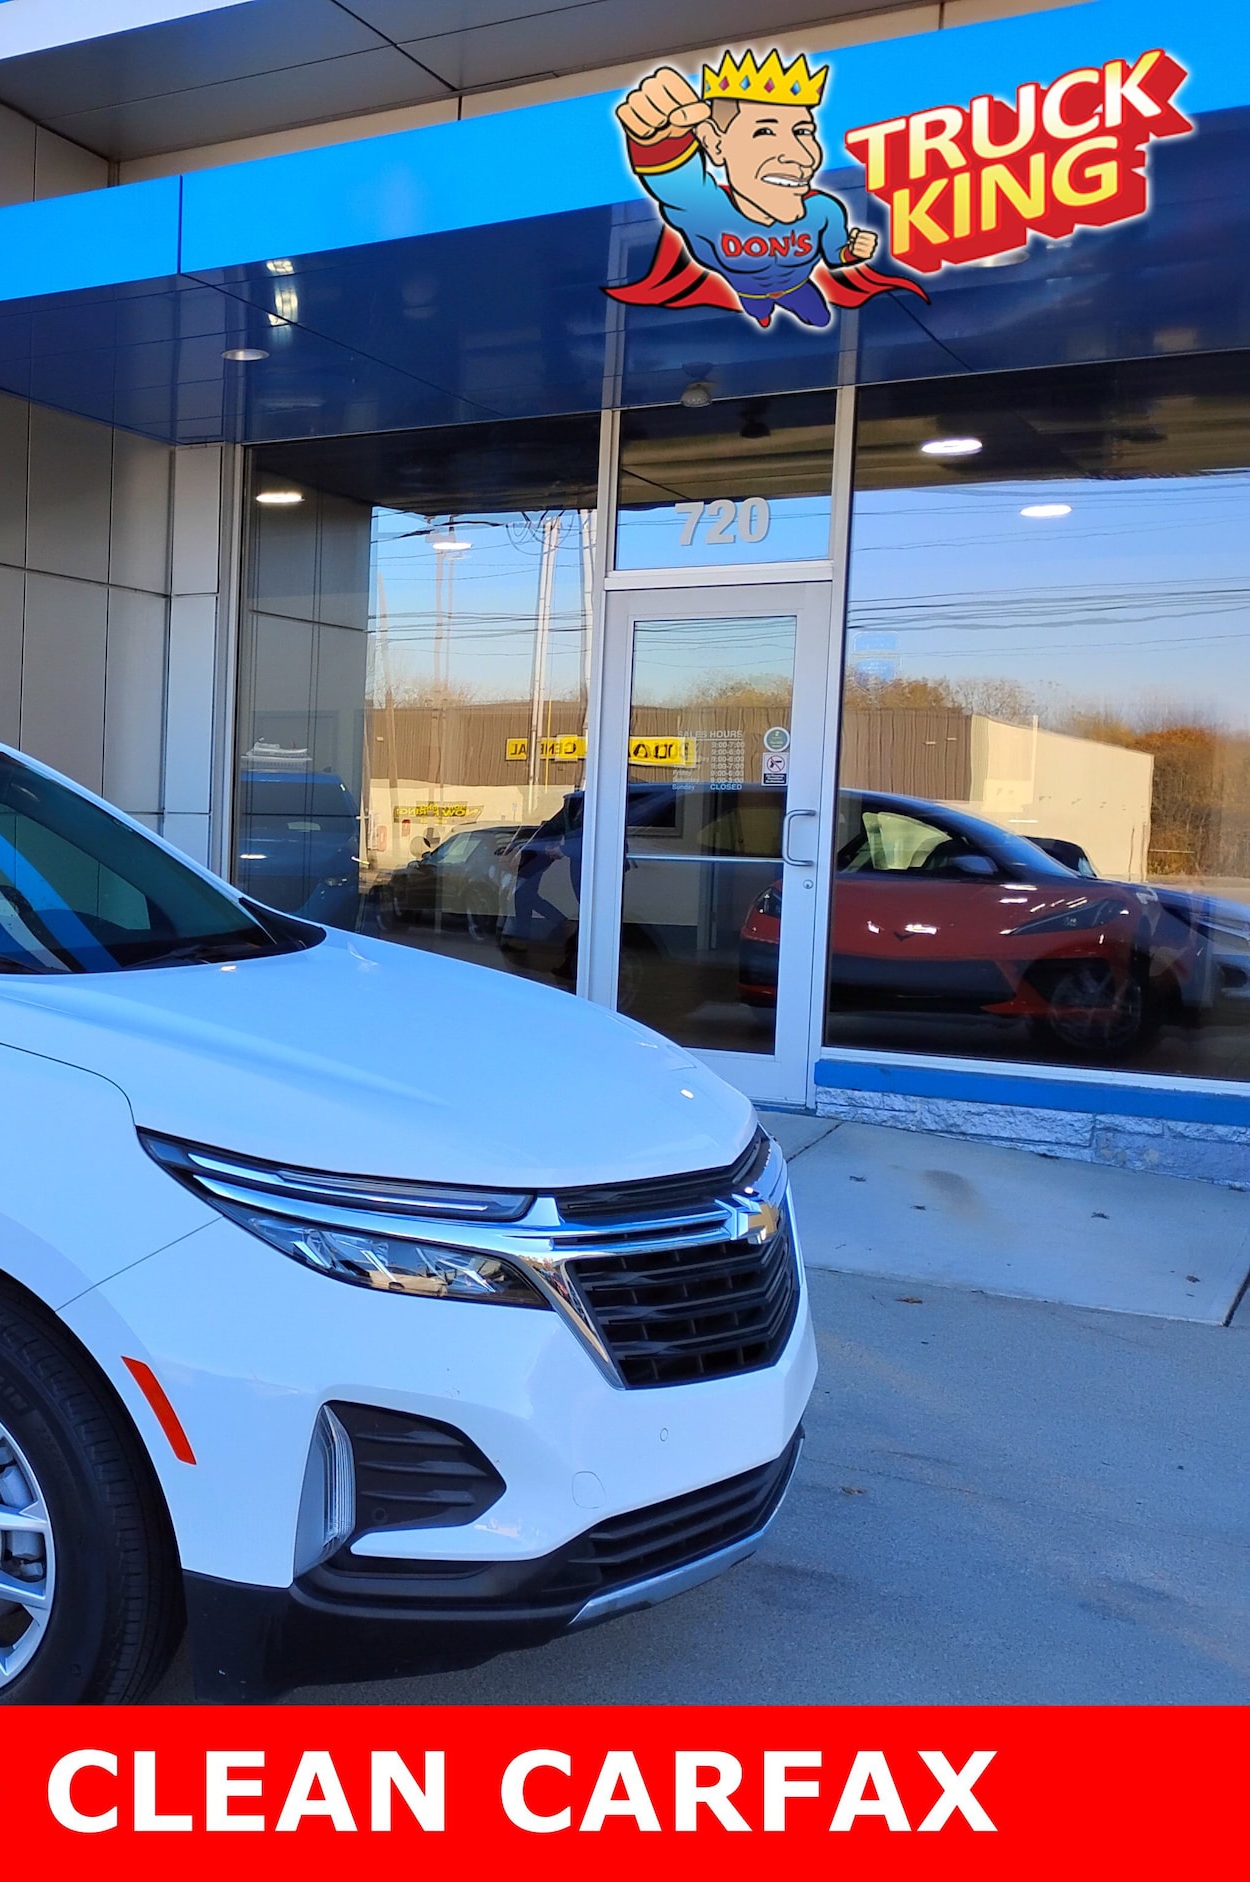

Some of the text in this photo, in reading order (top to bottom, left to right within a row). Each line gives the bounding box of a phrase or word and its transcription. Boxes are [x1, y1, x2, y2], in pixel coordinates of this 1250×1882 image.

[674, 496, 771, 546] 720
[678, 730, 743, 738] SALES HOURS
